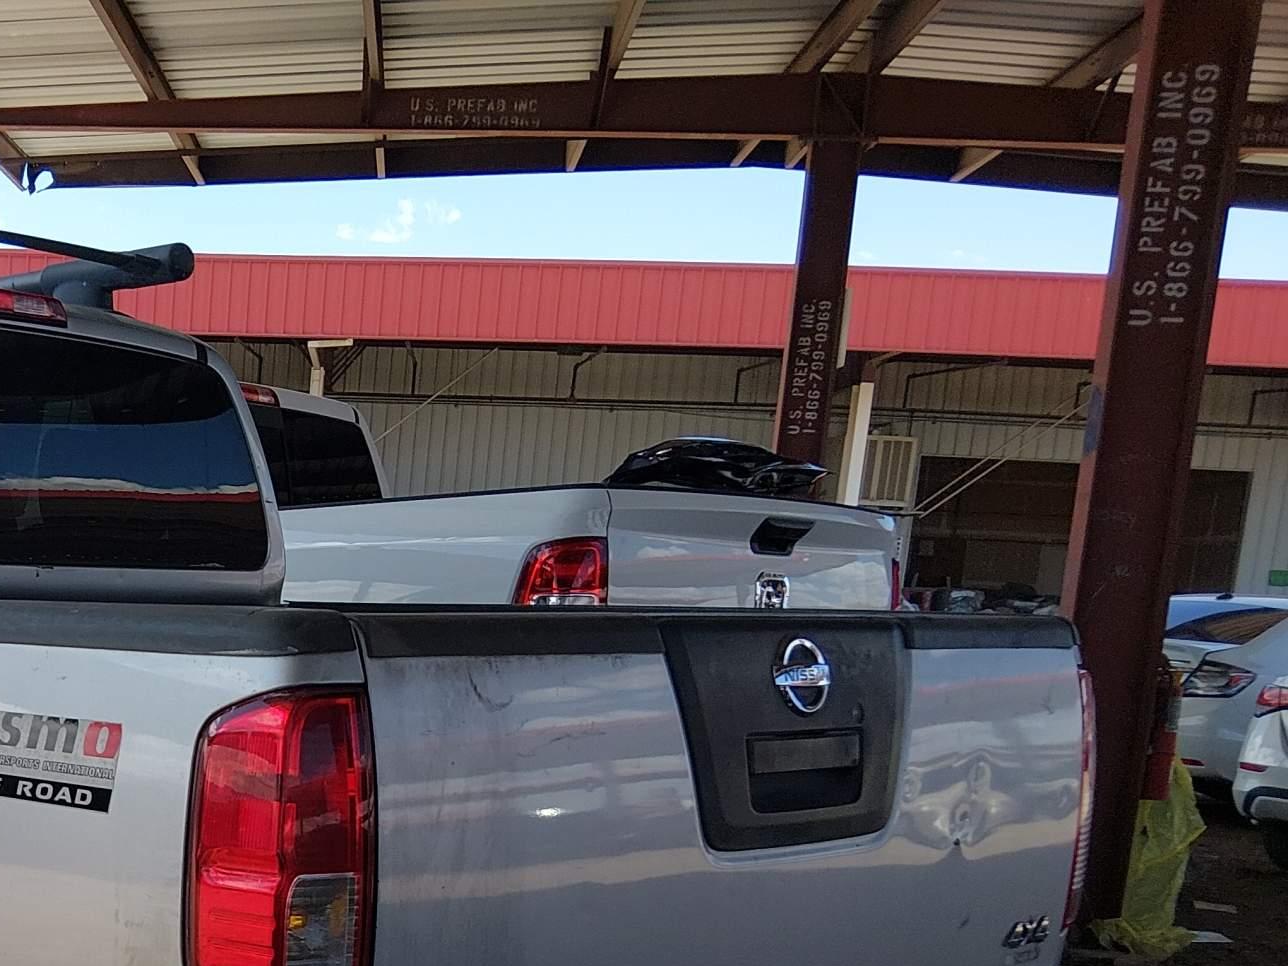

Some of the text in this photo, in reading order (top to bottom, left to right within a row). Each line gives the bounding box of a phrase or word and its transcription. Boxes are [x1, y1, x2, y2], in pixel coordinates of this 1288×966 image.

[447, 98, 507, 112] PREFAB
[1138, 136, 1179, 252] PREFAB
[1160, 63, 1221, 324] 1-866-799-0969
[1128, 271, 1160, 326] U.S.
[792, 336, 812, 397] PREFAB
[802, 300, 833, 434] 1-866-799-0969
[787, 405, 804, 435] U.S.
[15, 780, 94, 806] ROAD
[42, 761, 115, 779] INTERNATIONAL
